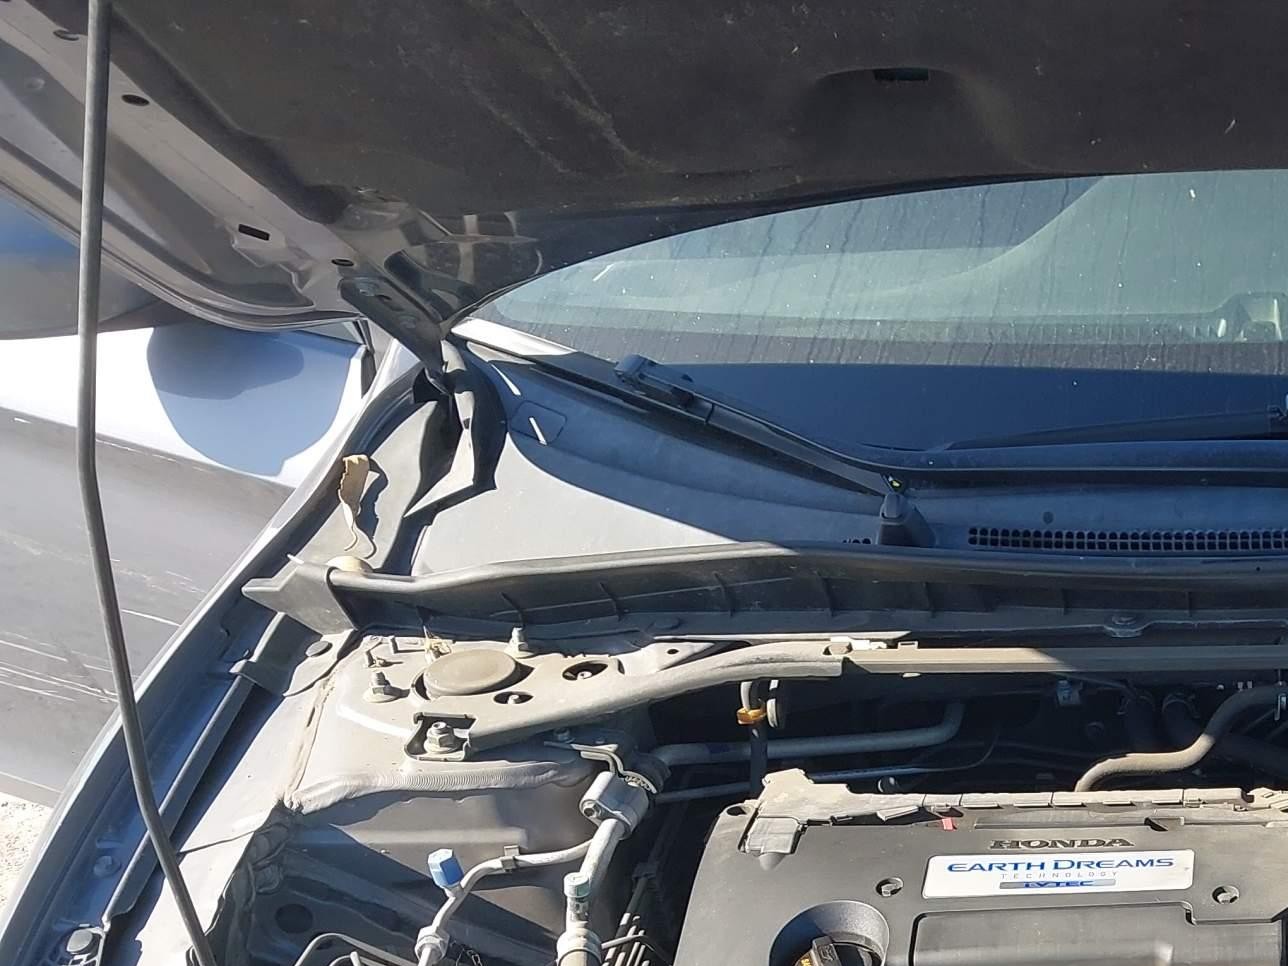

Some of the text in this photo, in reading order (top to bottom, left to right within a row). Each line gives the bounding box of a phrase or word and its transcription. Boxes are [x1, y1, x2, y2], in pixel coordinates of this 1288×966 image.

[990, 838, 1134, 849] HONDA
[947, 858, 1174, 872] EARTH DREAMS
[1000, 871, 1119, 880] TECHNOLOGY
